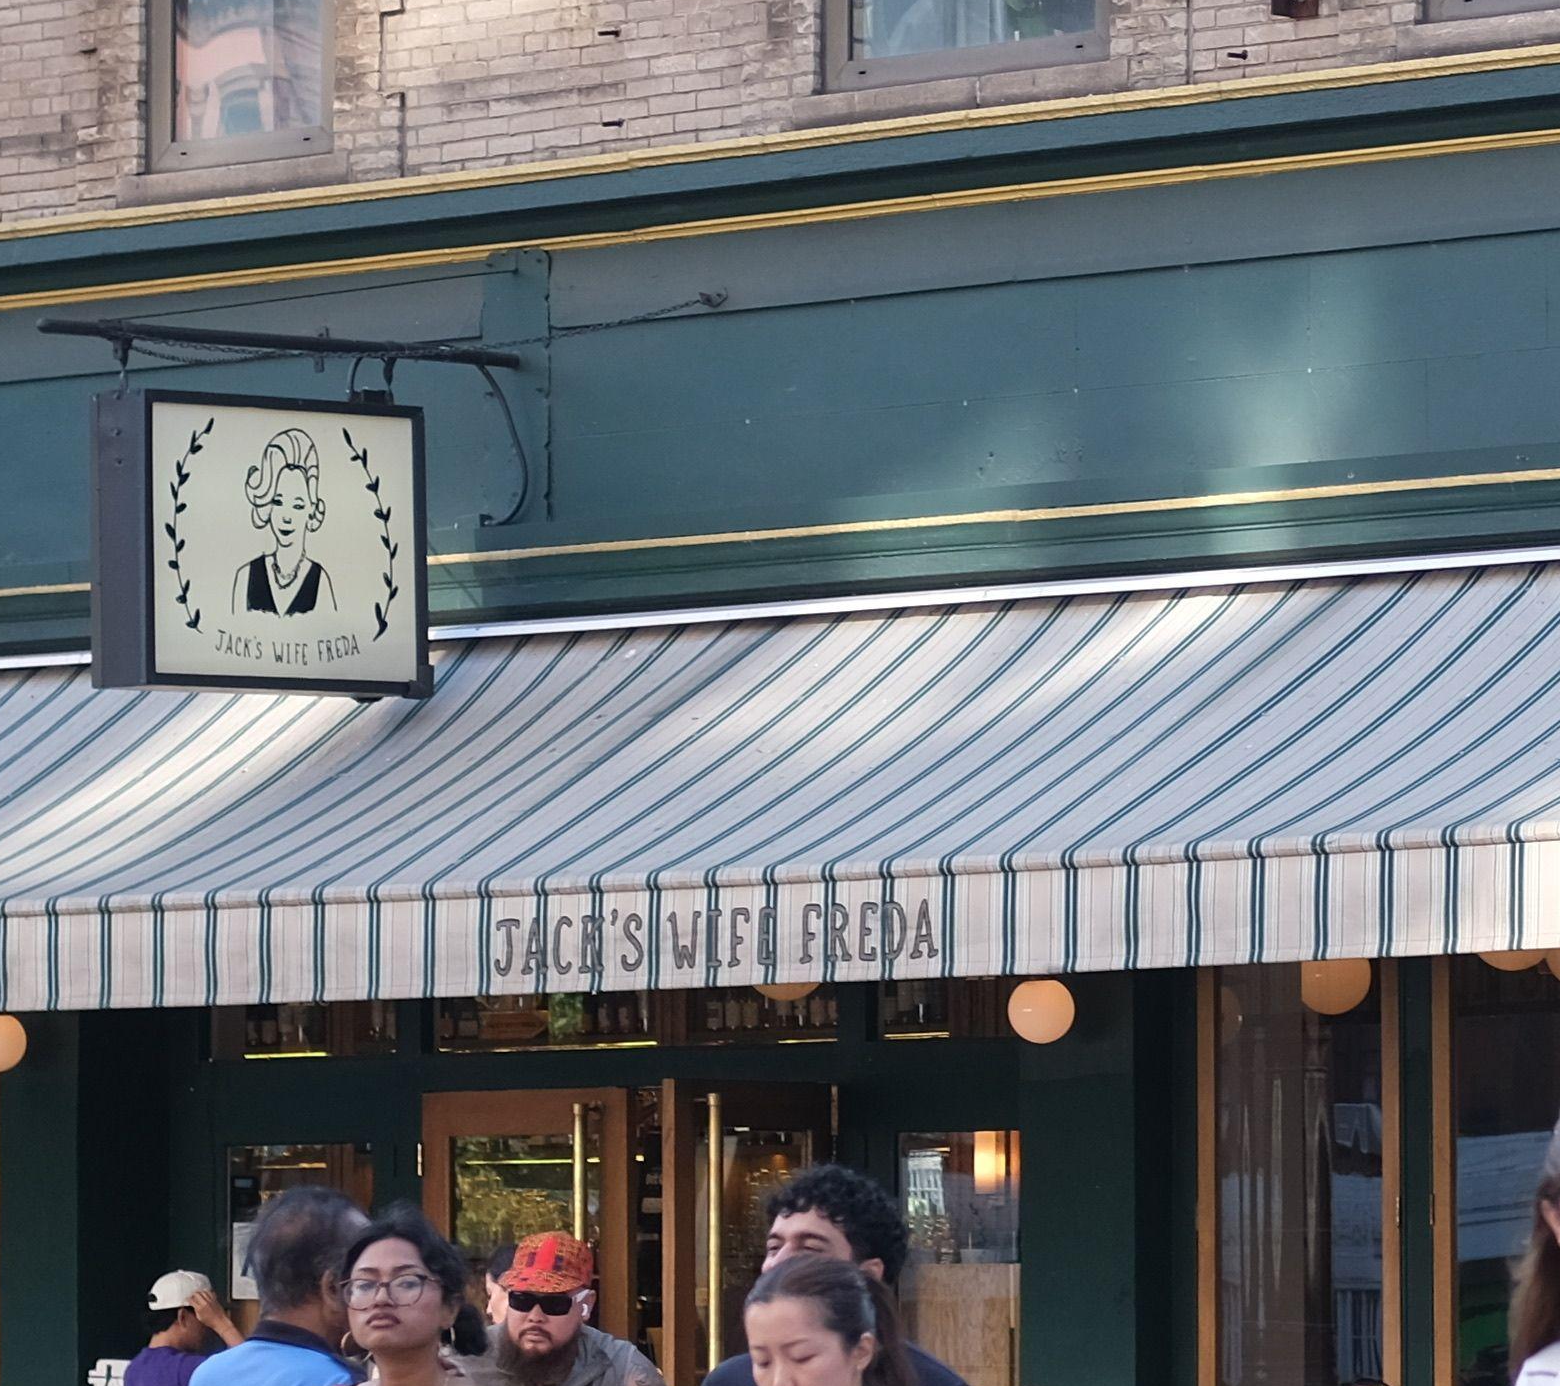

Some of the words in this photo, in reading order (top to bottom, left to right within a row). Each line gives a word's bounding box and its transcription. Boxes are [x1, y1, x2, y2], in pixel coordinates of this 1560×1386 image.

[215, 629, 263, 659] JACK'S
[272, 641, 308, 665] WIFE
[317, 634, 360, 662] FREDA
[493, 907, 644, 978] JACK'S
[667, 905, 777, 970] WIFE
[797, 898, 940, 965] FREDA
